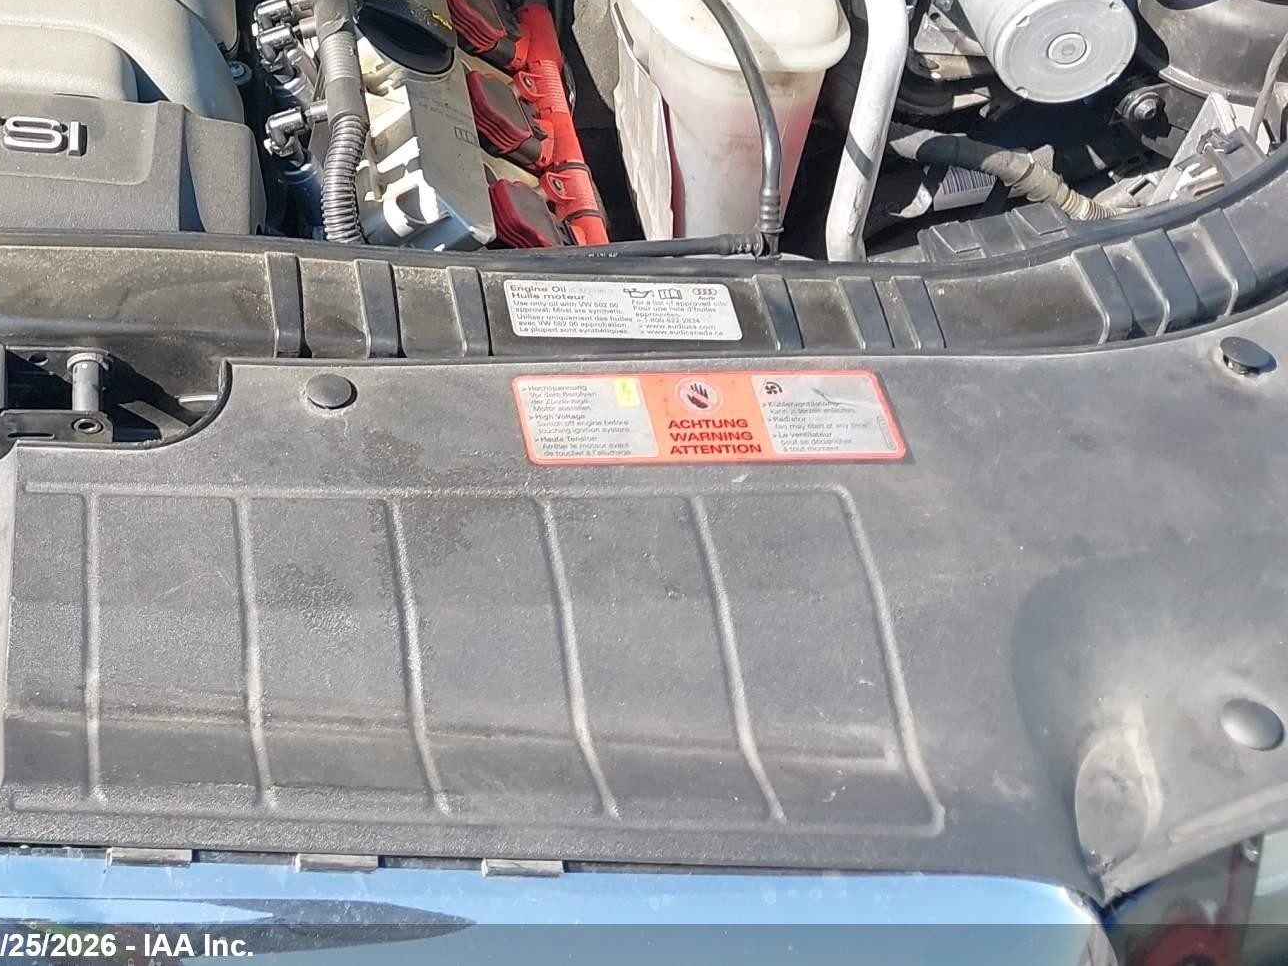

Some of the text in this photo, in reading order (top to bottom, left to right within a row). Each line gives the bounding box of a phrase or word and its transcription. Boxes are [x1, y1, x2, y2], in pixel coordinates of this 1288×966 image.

[509, 284, 548, 294] Engine
[551, 285, 566, 293] Oil
[668, 418, 749, 430] ACHTUNG
[669, 431, 754, 442] WARNING
[670, 443, 763, 455] ATTENTION
